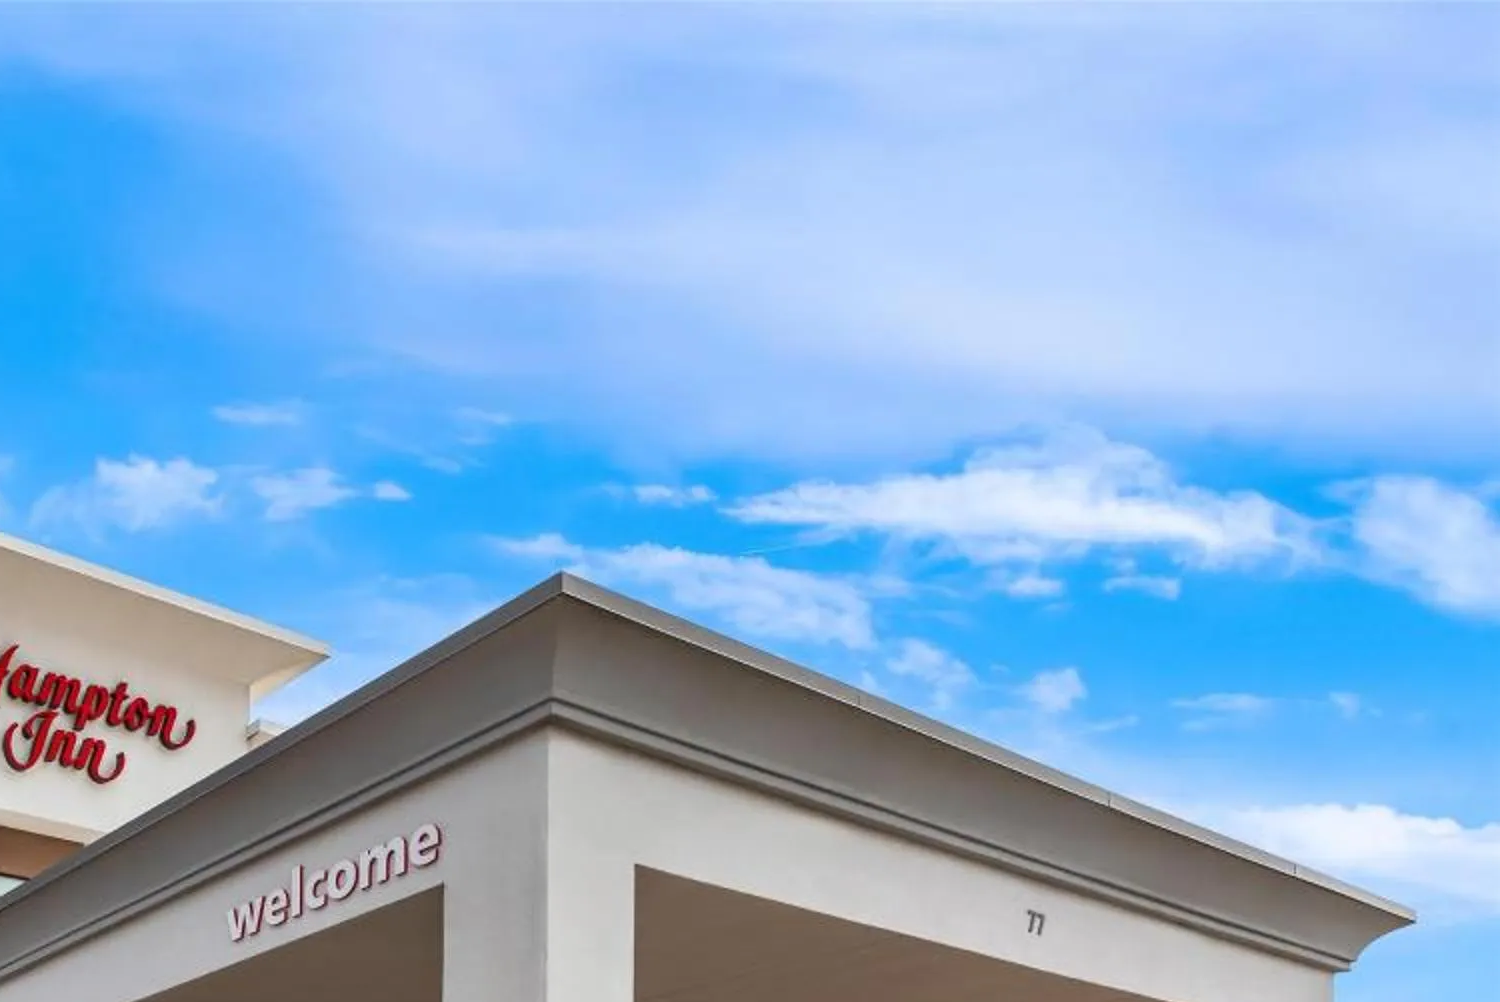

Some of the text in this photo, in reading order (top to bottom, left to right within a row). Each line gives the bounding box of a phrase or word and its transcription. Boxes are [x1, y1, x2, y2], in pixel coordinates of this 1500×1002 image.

[2, 709, 126, 784] Inn
[228, 823, 442, 943] welcome
[1027, 909, 1045, 936] 77
